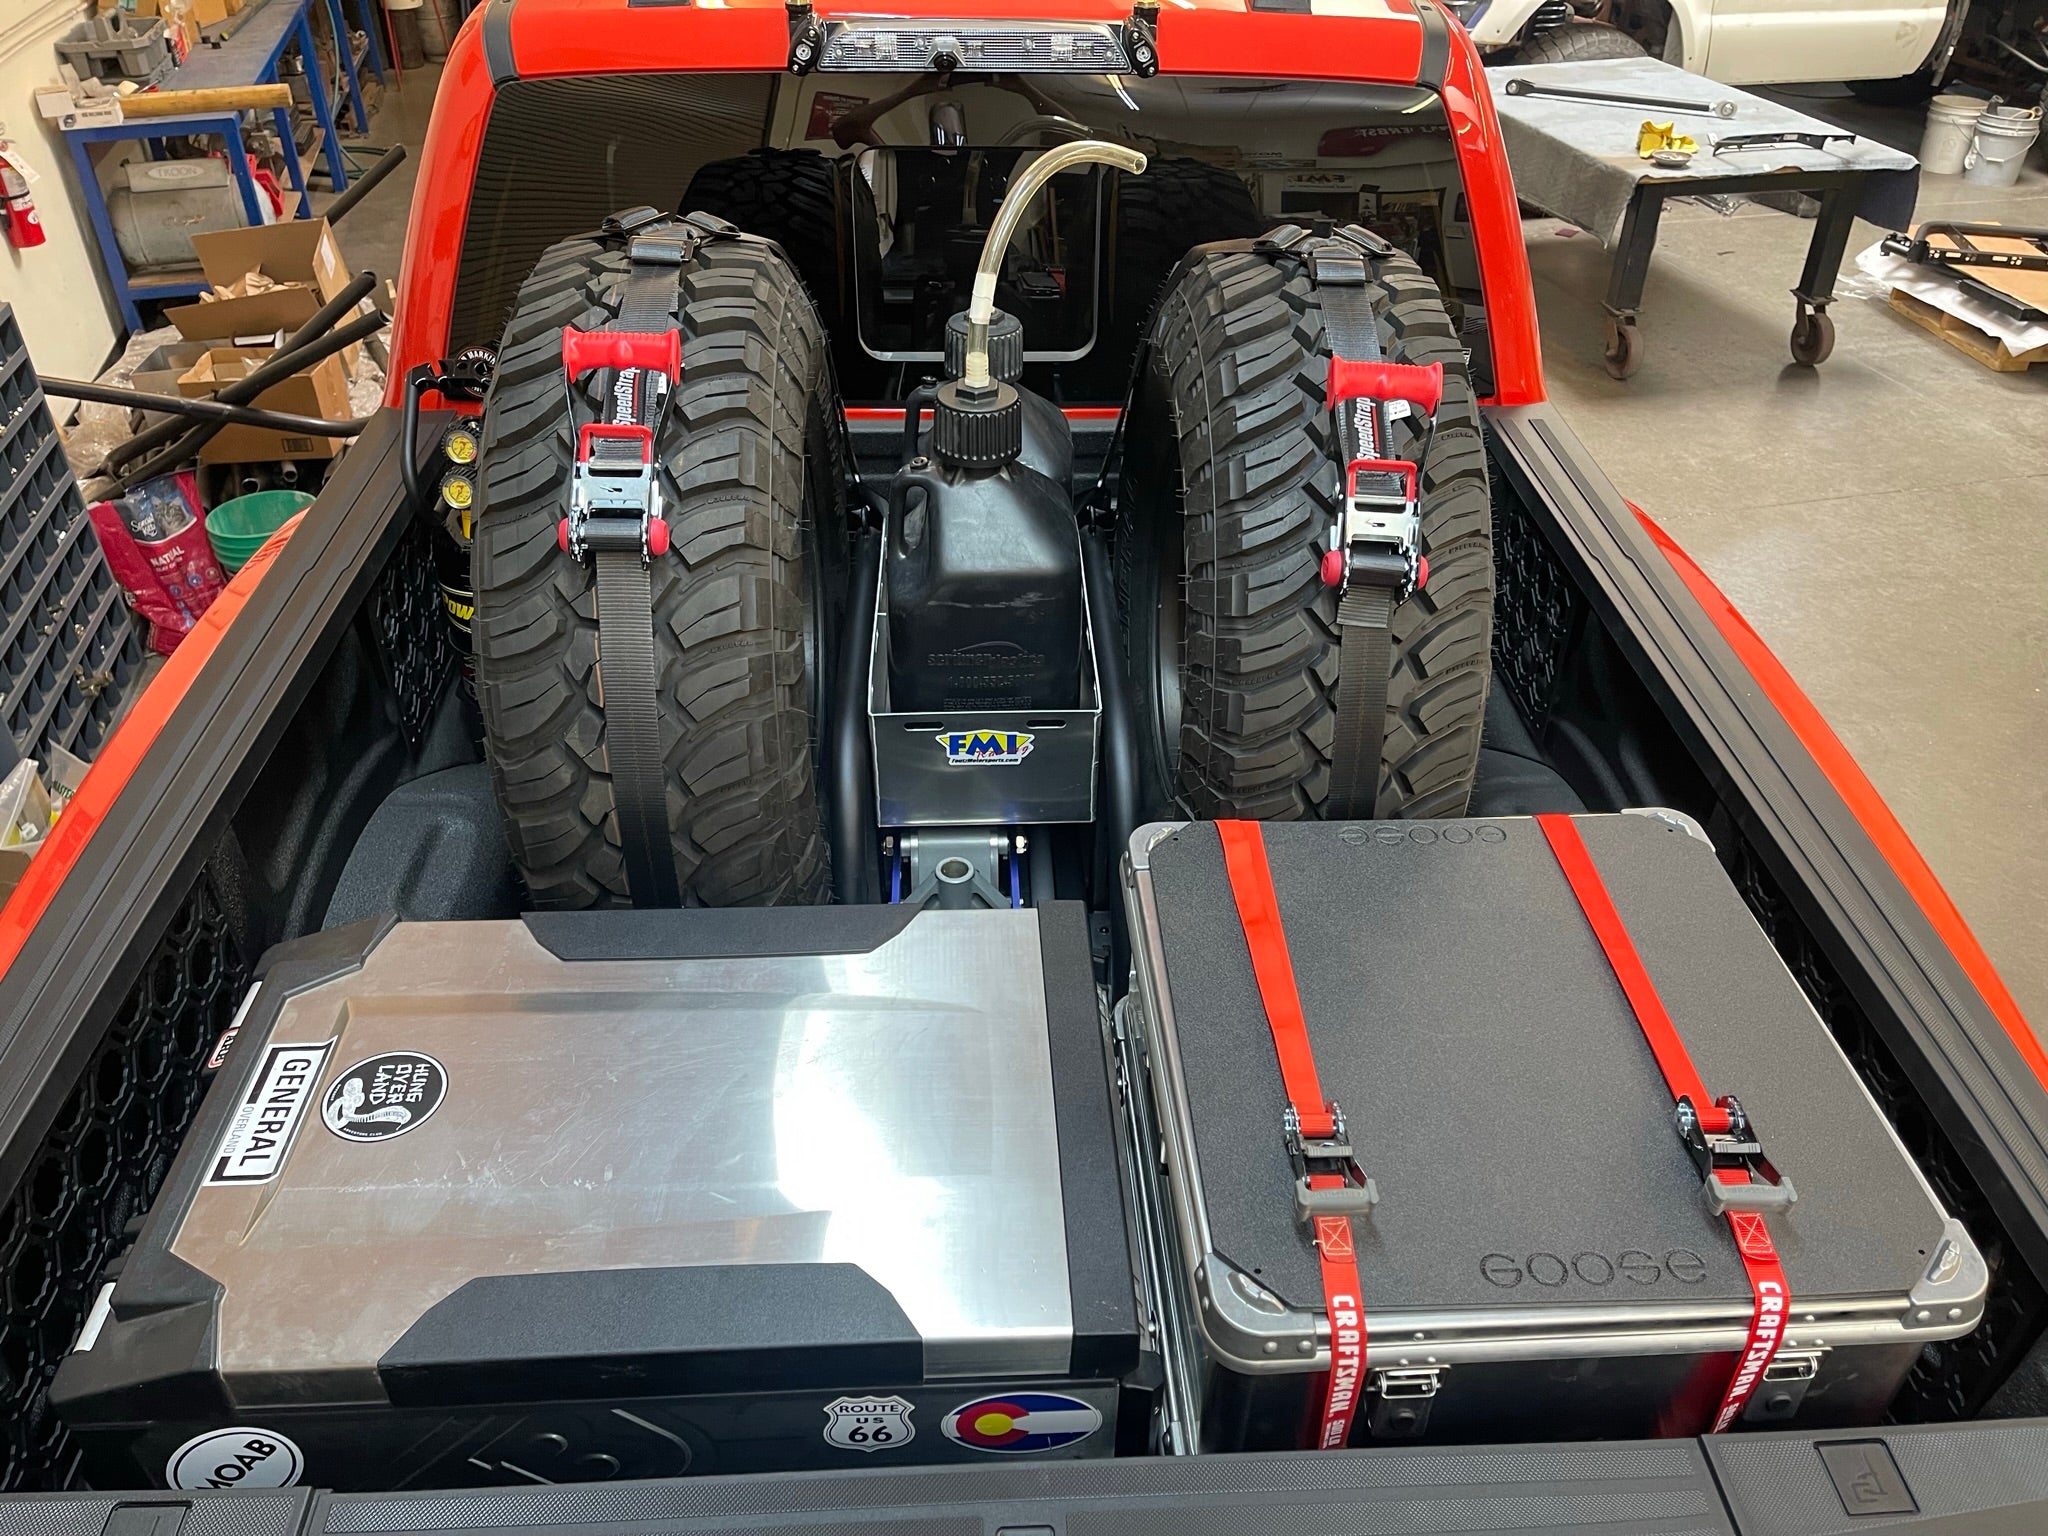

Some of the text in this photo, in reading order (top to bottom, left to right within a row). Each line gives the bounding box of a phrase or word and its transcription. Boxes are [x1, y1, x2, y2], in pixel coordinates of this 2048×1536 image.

[1356, 397, 1381, 461] SpeedStrap
[949, 734, 1018, 756] FMI
[369, 1064, 390, 1105] LAND
[410, 1063, 430, 1103] HUNG
[223, 1106, 255, 1154] OVERLAND
[238, 1057, 312, 1167] GENERAL
[839, 1403, 899, 1414] ROUTE
[855, 1416, 885, 1425] US
[848, 1425, 893, 1443] 66
